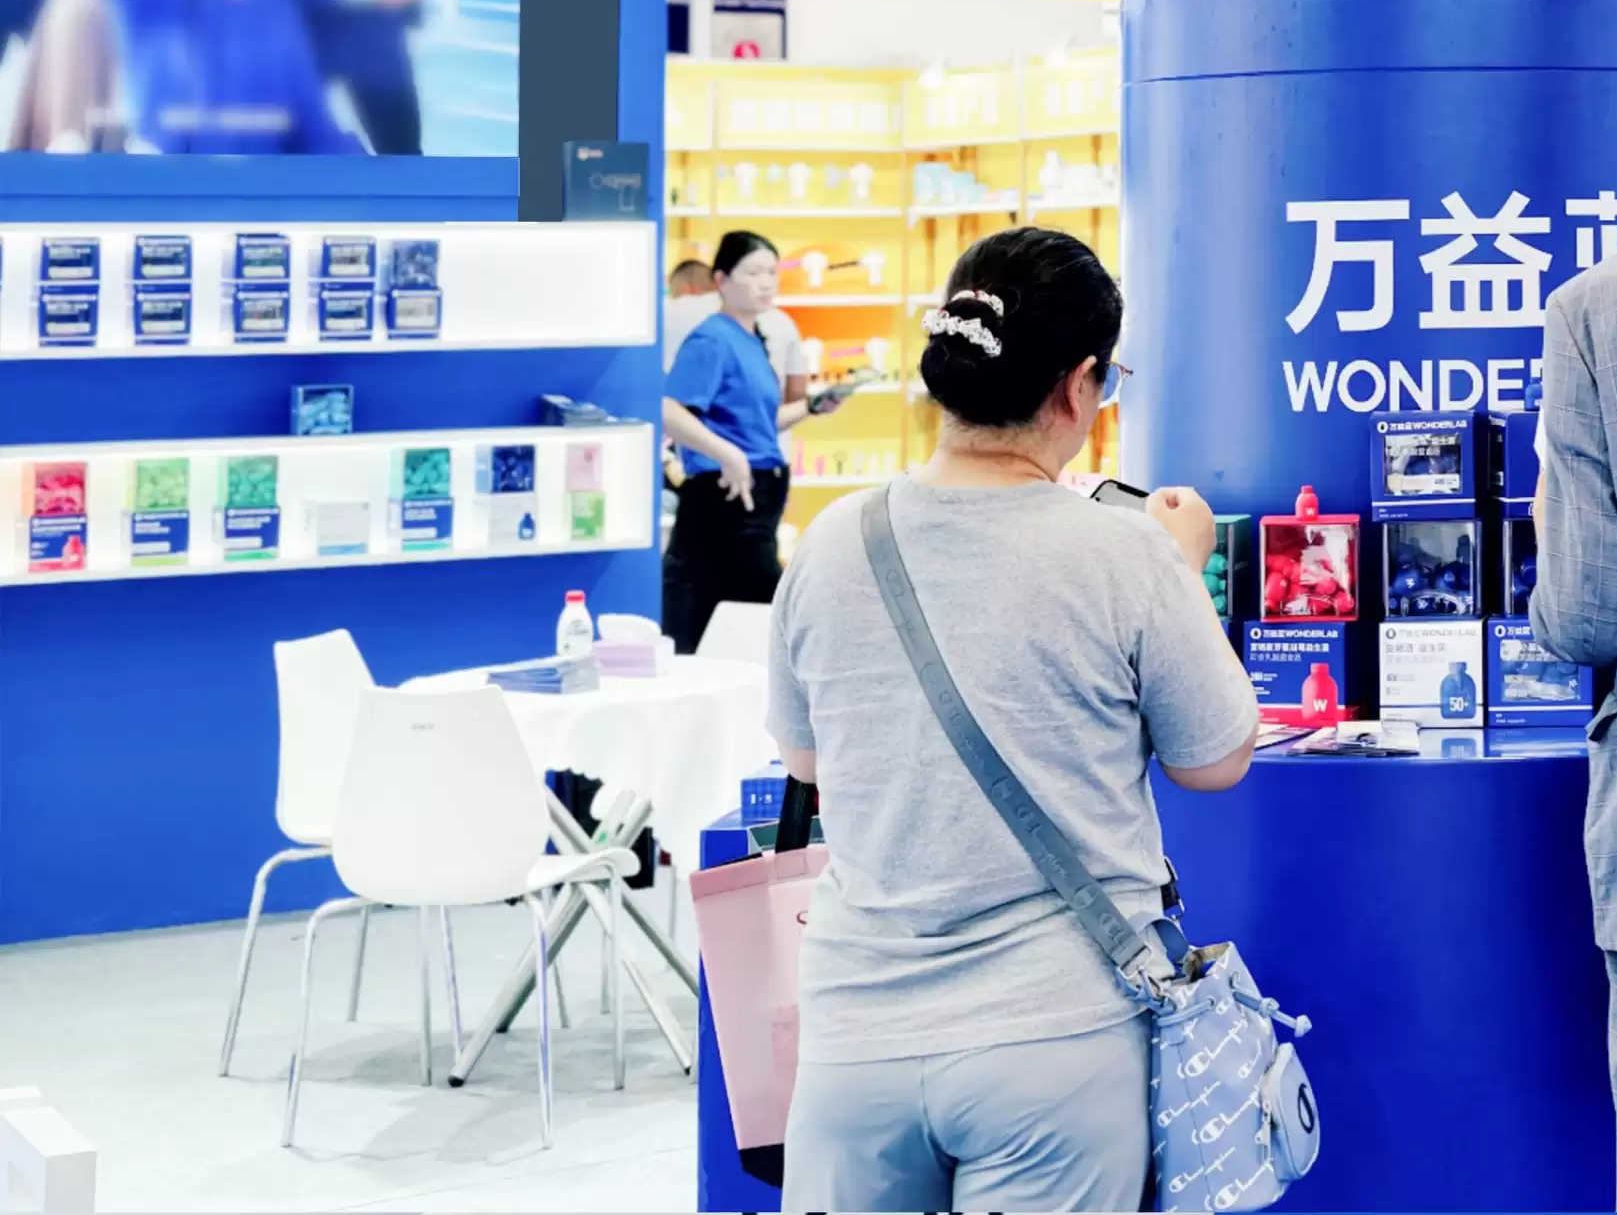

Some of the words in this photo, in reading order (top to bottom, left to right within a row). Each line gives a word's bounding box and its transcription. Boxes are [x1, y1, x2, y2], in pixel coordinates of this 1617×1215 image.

[1282, 358, 1543, 413] WONDE
[1313, 699, 1328, 713] W
[1449, 696, 1470, 713] 50+
